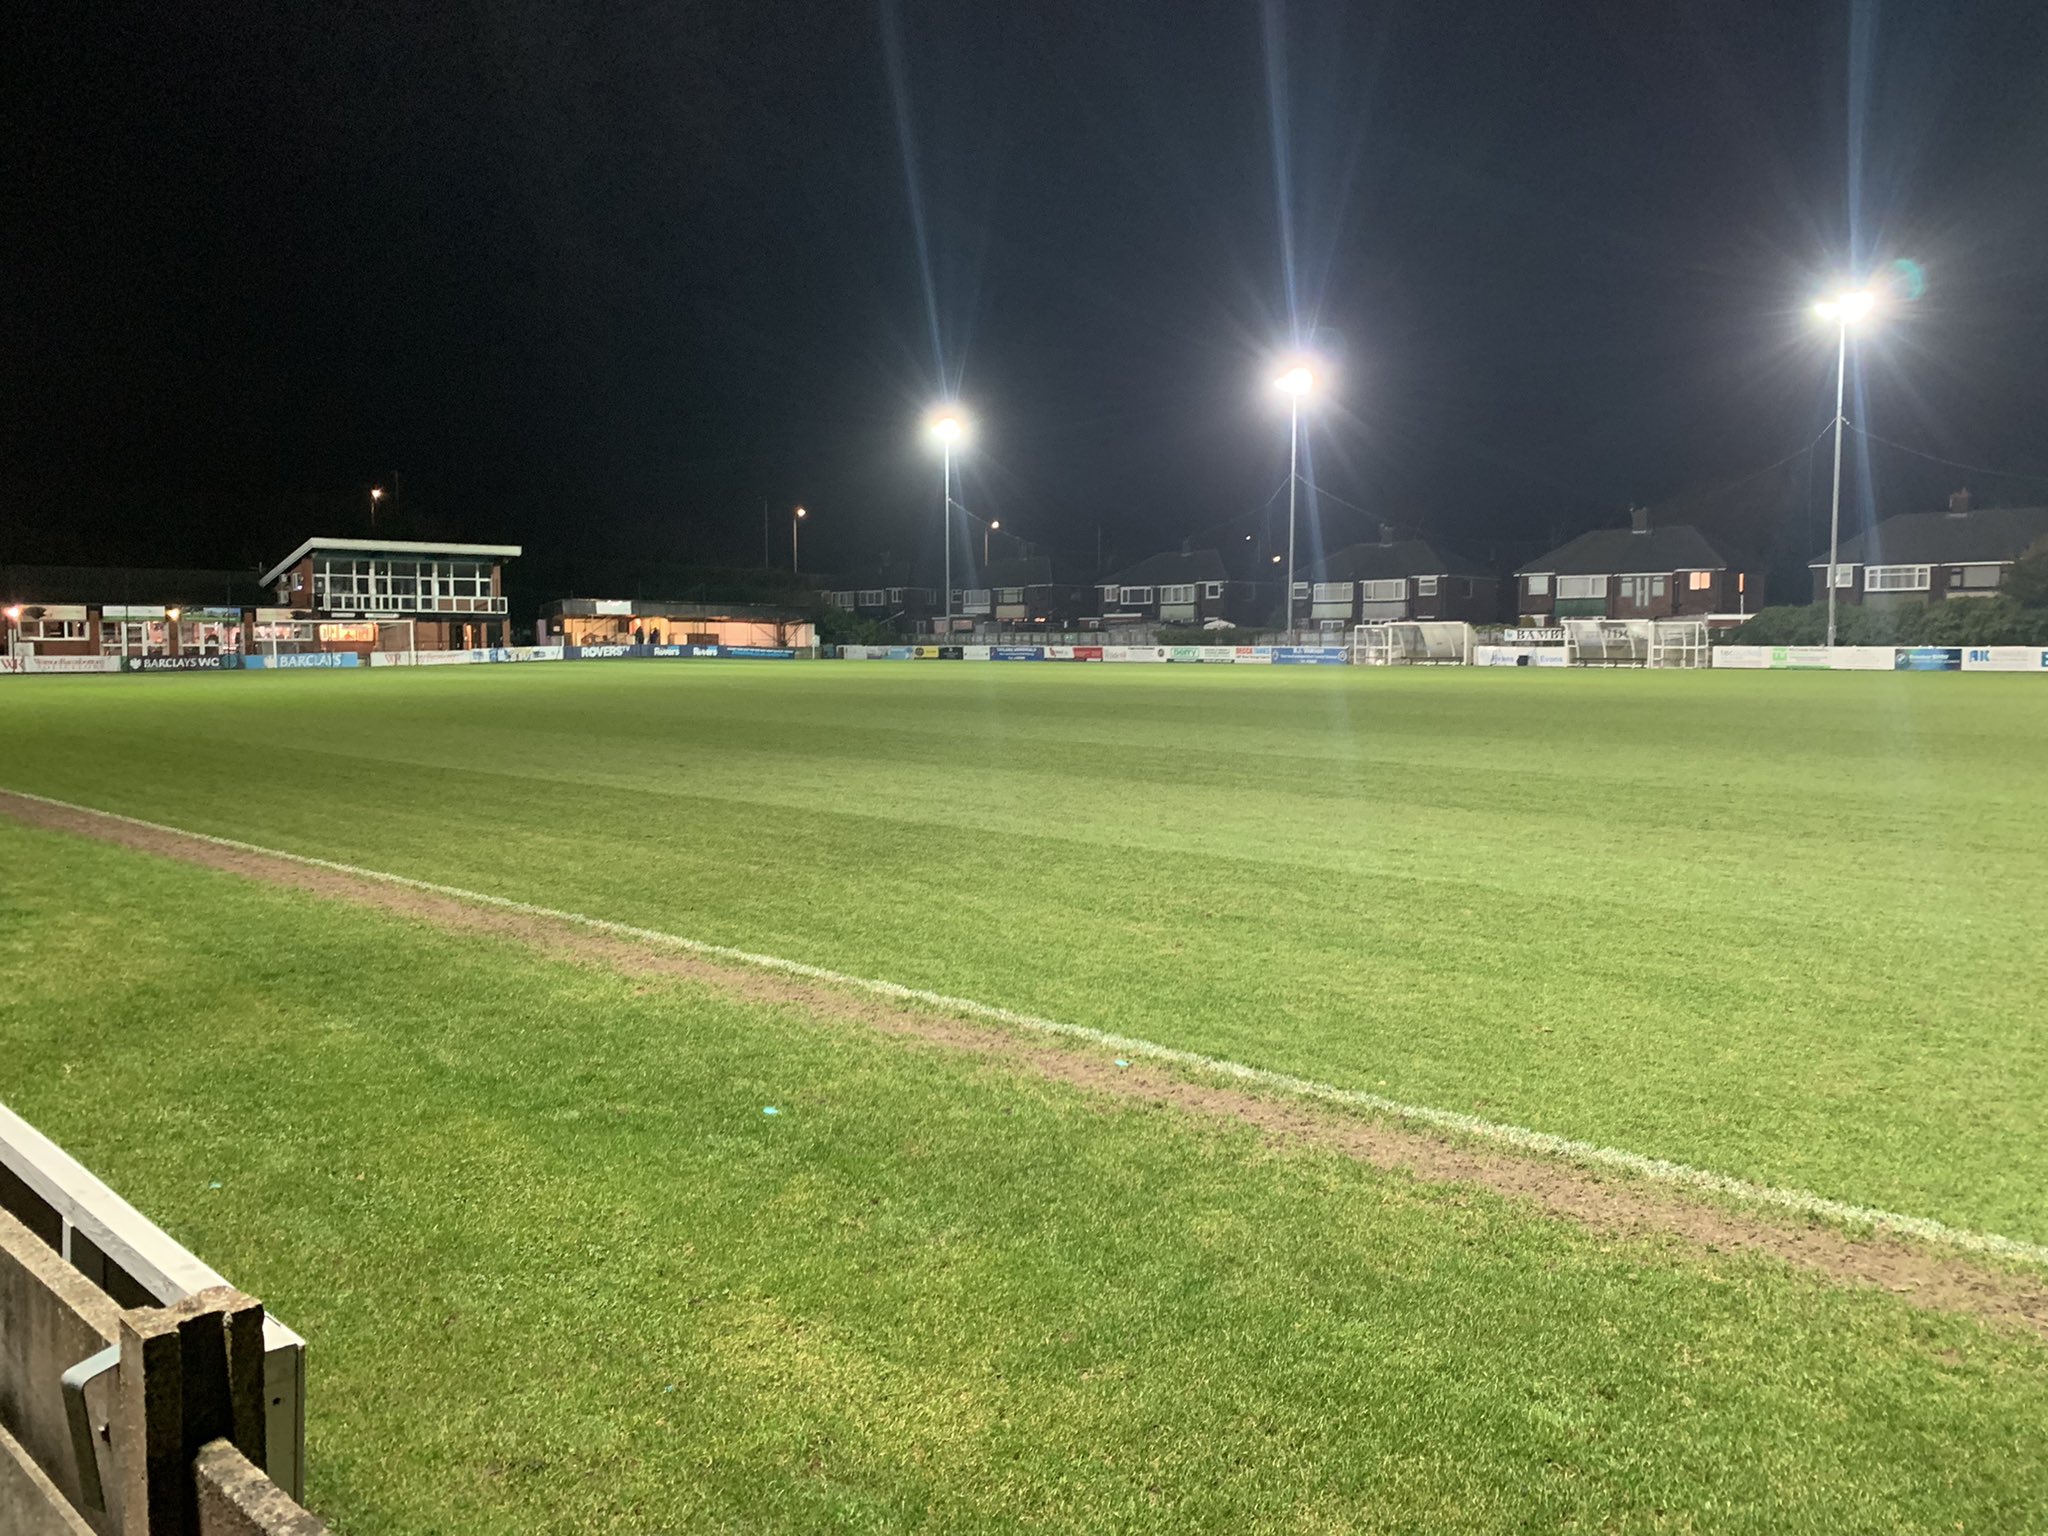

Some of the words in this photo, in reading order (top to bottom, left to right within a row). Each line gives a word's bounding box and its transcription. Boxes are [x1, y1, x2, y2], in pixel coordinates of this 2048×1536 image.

[581, 646, 623, 658] ROVERS
[143, 658, 197, 668] BARCLAYS
[197, 657, 220, 667] WC
[279, 654, 342, 668] BARCLAYS
